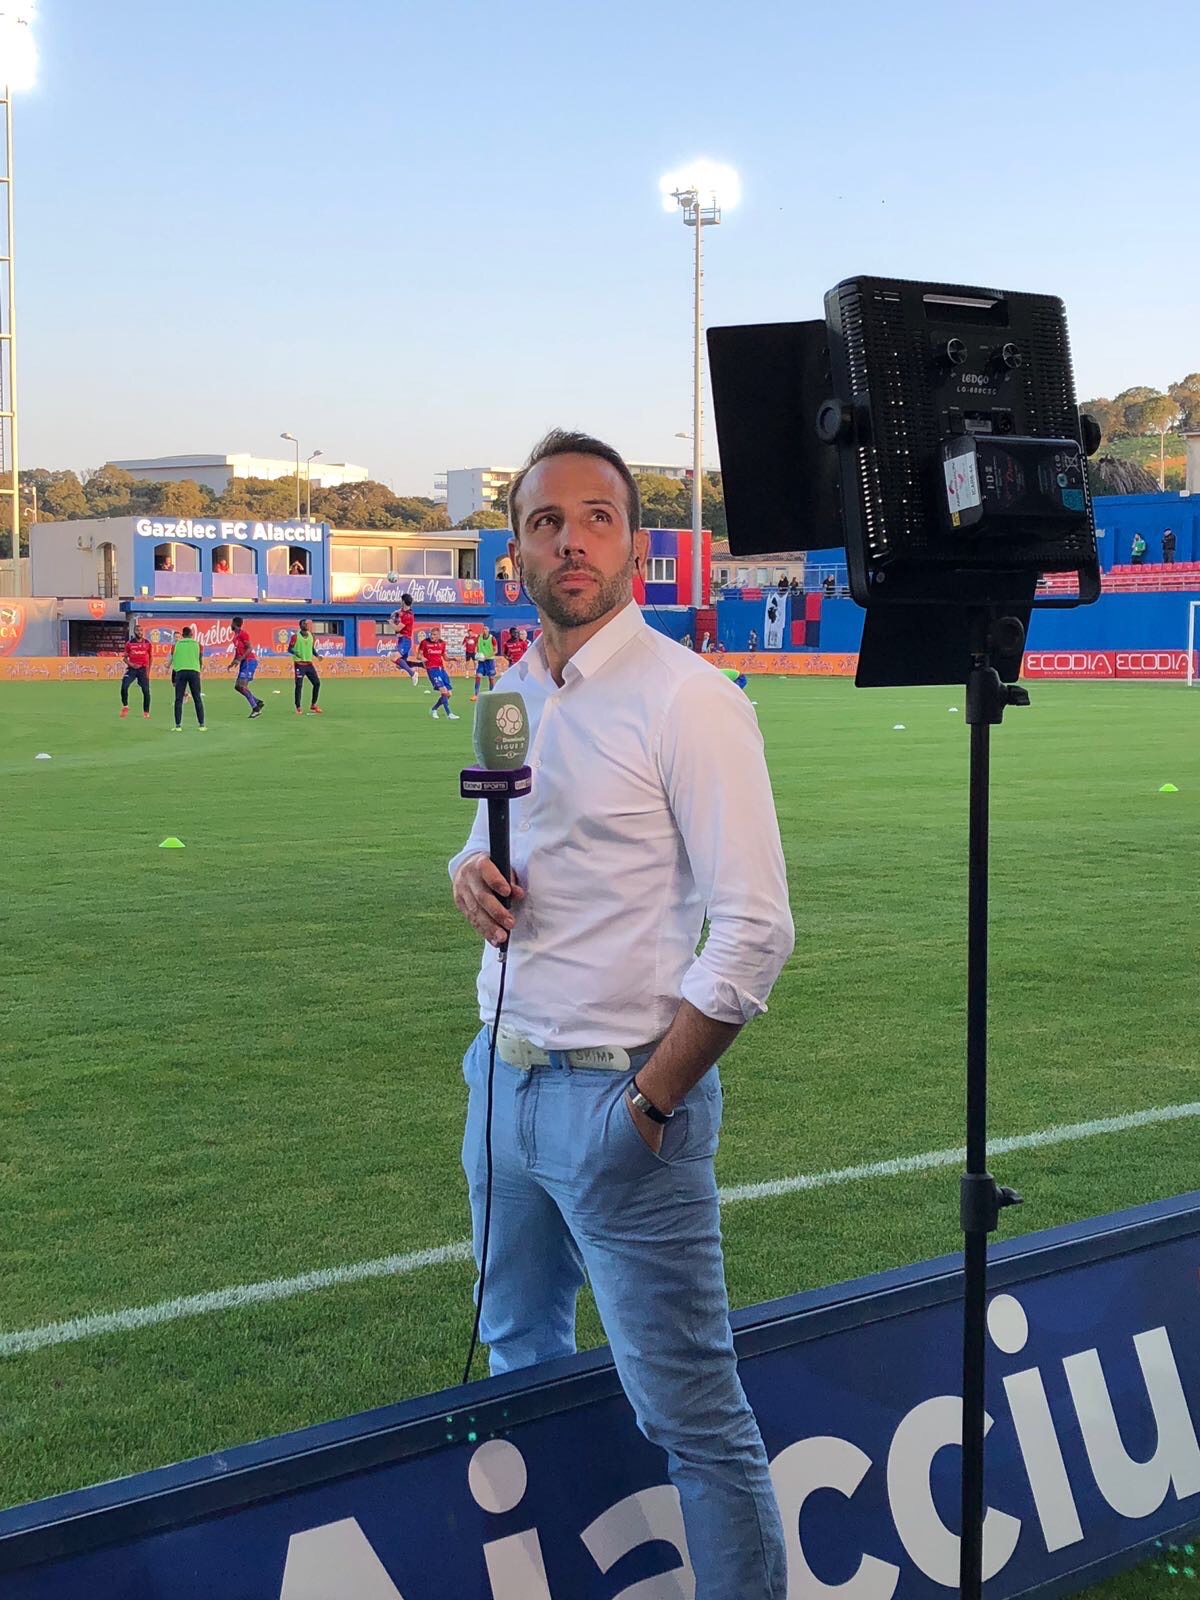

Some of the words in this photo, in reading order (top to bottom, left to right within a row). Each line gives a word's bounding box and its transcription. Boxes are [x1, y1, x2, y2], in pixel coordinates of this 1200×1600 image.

[136, 518, 217, 539] Gazélec
[221, 522, 248, 540] FC
[1027, 653, 1113, 674] ECODIA
[1116, 653, 1195, 674] ECODIA
[575, 1048, 615, 1063] SKIMP
